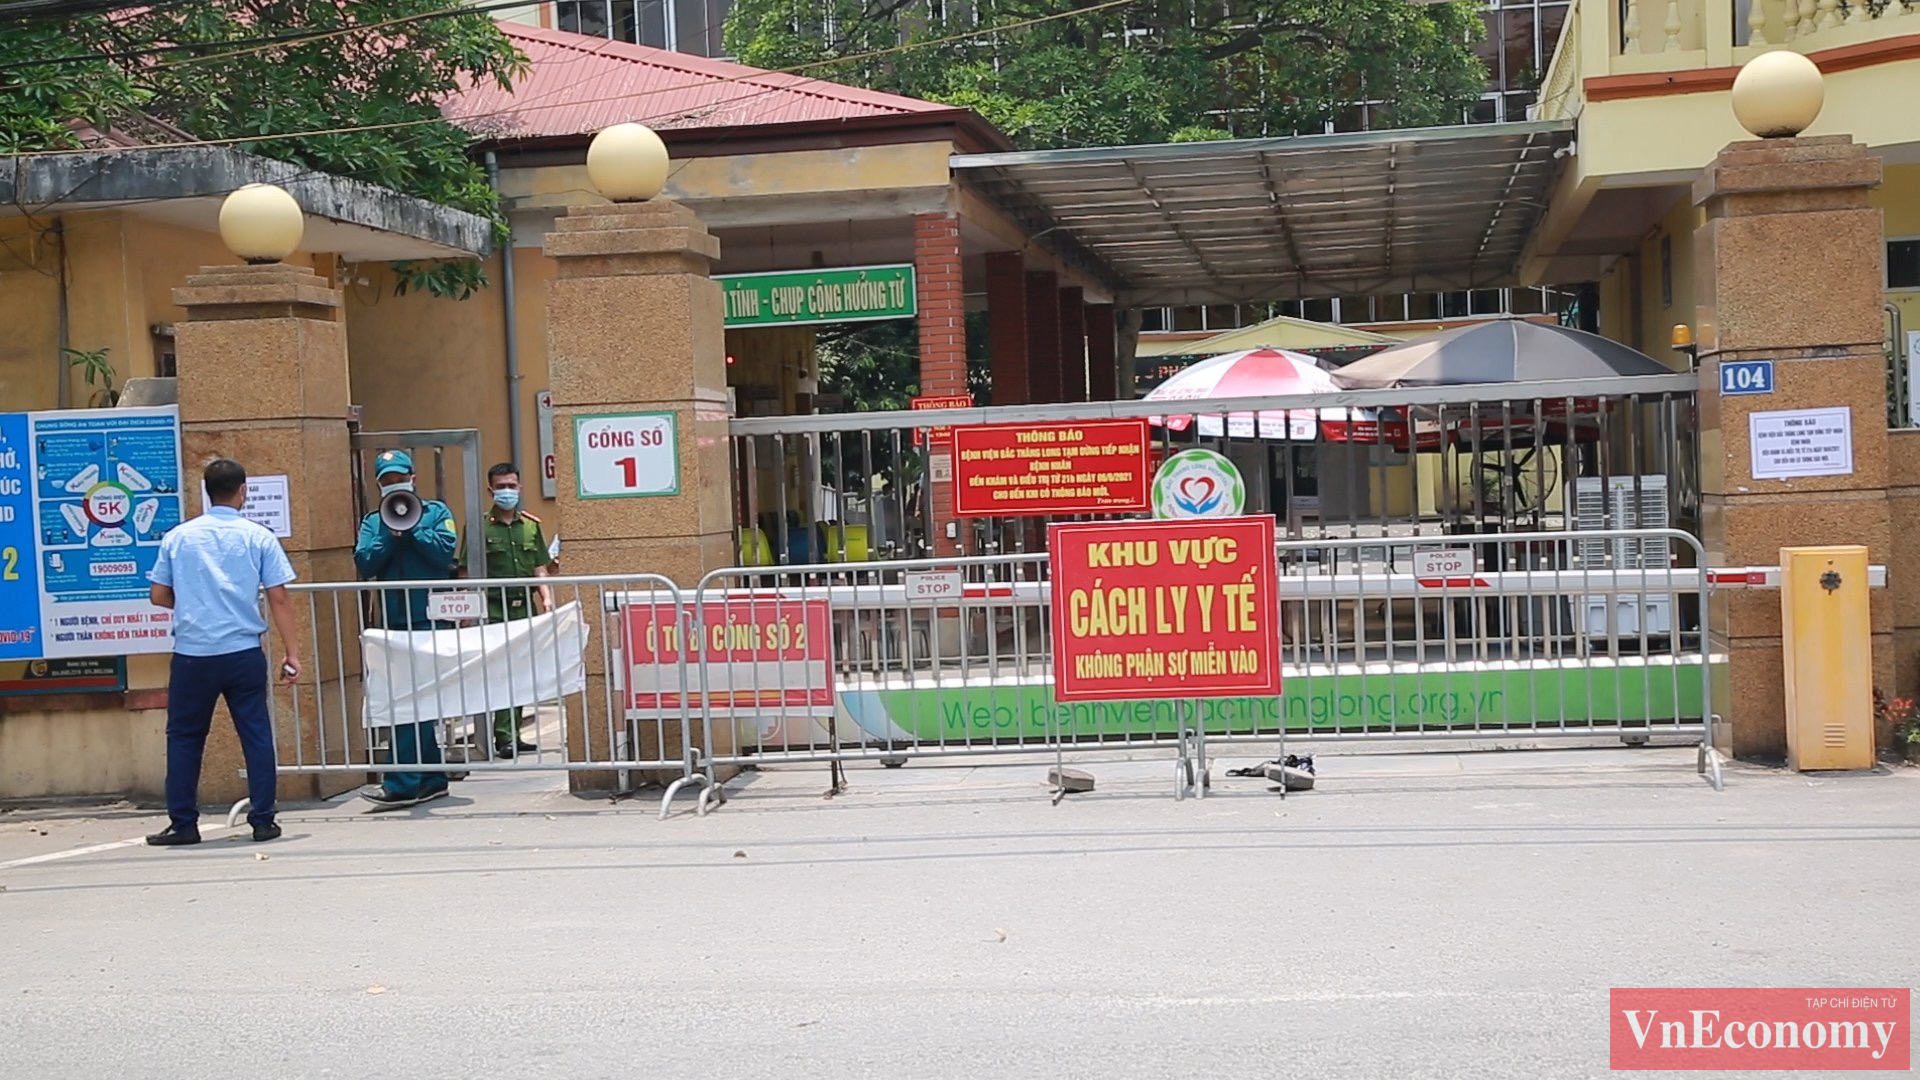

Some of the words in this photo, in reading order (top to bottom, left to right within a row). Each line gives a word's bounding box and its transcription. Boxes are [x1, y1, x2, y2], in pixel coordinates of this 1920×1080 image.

[729, 282, 759, 317] TÍNH
[771, 286, 804, 319] CHỤP
[808, 279, 842, 318] CỘNG
[844, 272, 886, 311] HƯỞNG
[889, 272, 905, 309] TỪ
[1725, 366, 1765, 389] 104
[588, 424, 635, 448] CỔNG
[640, 424, 663, 446] SỐ
[1016, 430, 1056, 443] THÔNG
[1058, 428, 1083, 441] BÁO
[614, 457, 637, 488] 1
[1061, 473, 1075, 484] 21h
[98, 501, 123, 516] 5K
[2, 547, 19, 580] 2
[1087, 540, 1158, 567] KHU
[1168, 536, 1237, 568] VỰC
[92, 563, 134, 573] 19009095
[1426, 561, 1462, 572] STOP
[917, 583, 951, 594] STOP
[440, 603, 470, 613] STOP
[1069, 578, 1147, 637] CÁCH
[1155, 585, 1188, 634] LY
[1196, 584, 1214, 633] Y
[1222, 566, 1258, 632] TẾ
[712, 613, 761, 651] CỔNG
[766, 613, 791, 650] SỐ
[795, 623, 805, 649] 2
[1075, 648, 1123, 679] KHÔNG
[1126, 647, 1165, 682] PHẬN
[1168, 648, 1188, 680] SỰ
[1190, 641, 1227, 675] MIỄN
[1229, 645, 1258, 674] VÀO
[943, 701, 1019, 729] Web:
